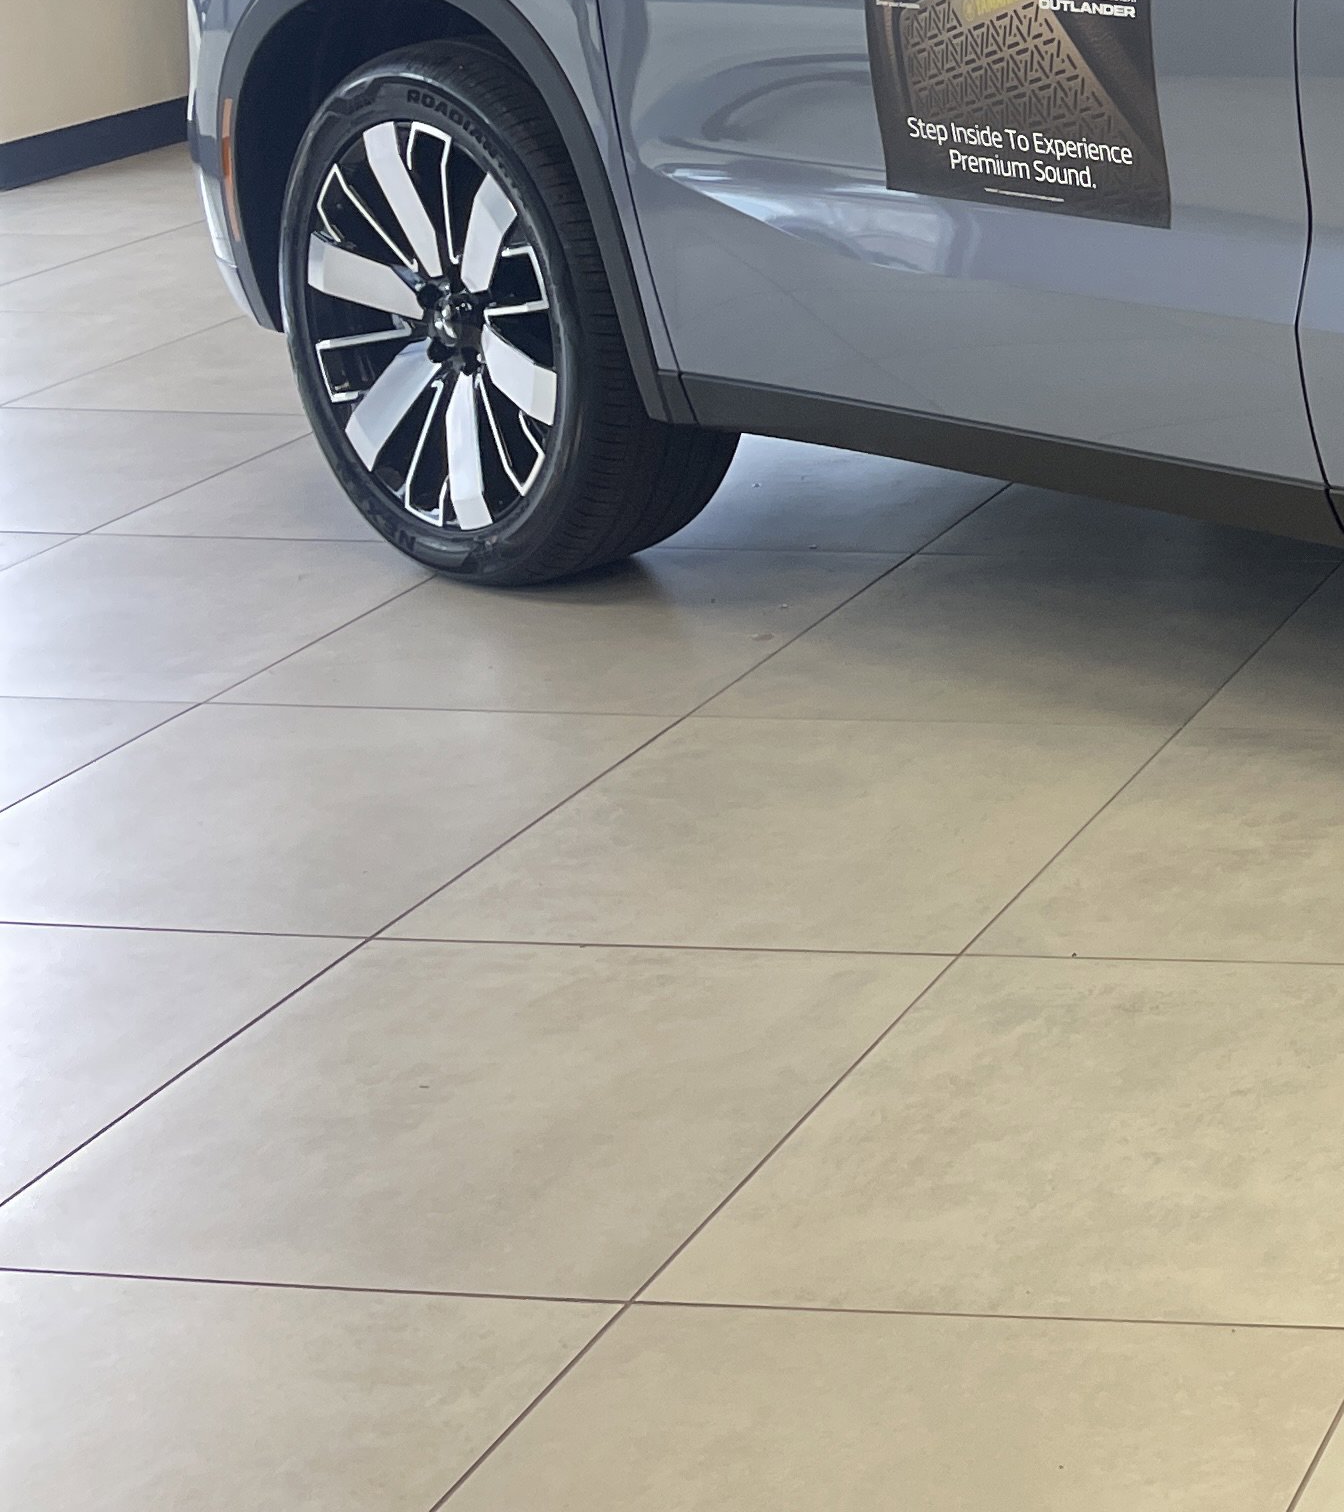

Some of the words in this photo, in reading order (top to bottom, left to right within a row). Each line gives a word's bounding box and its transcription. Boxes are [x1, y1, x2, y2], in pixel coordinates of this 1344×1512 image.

[1038, 0, 1136, 18] OUTLANDER
[907, 116, 948, 146] Step
[950, 122, 1003, 149] Inside
[1004, 128, 1030, 152] To
[1033, 133, 1133, 165] Experience
[949, 149, 1031, 180] Premium
[1033, 160, 1097, 189] Sound.
